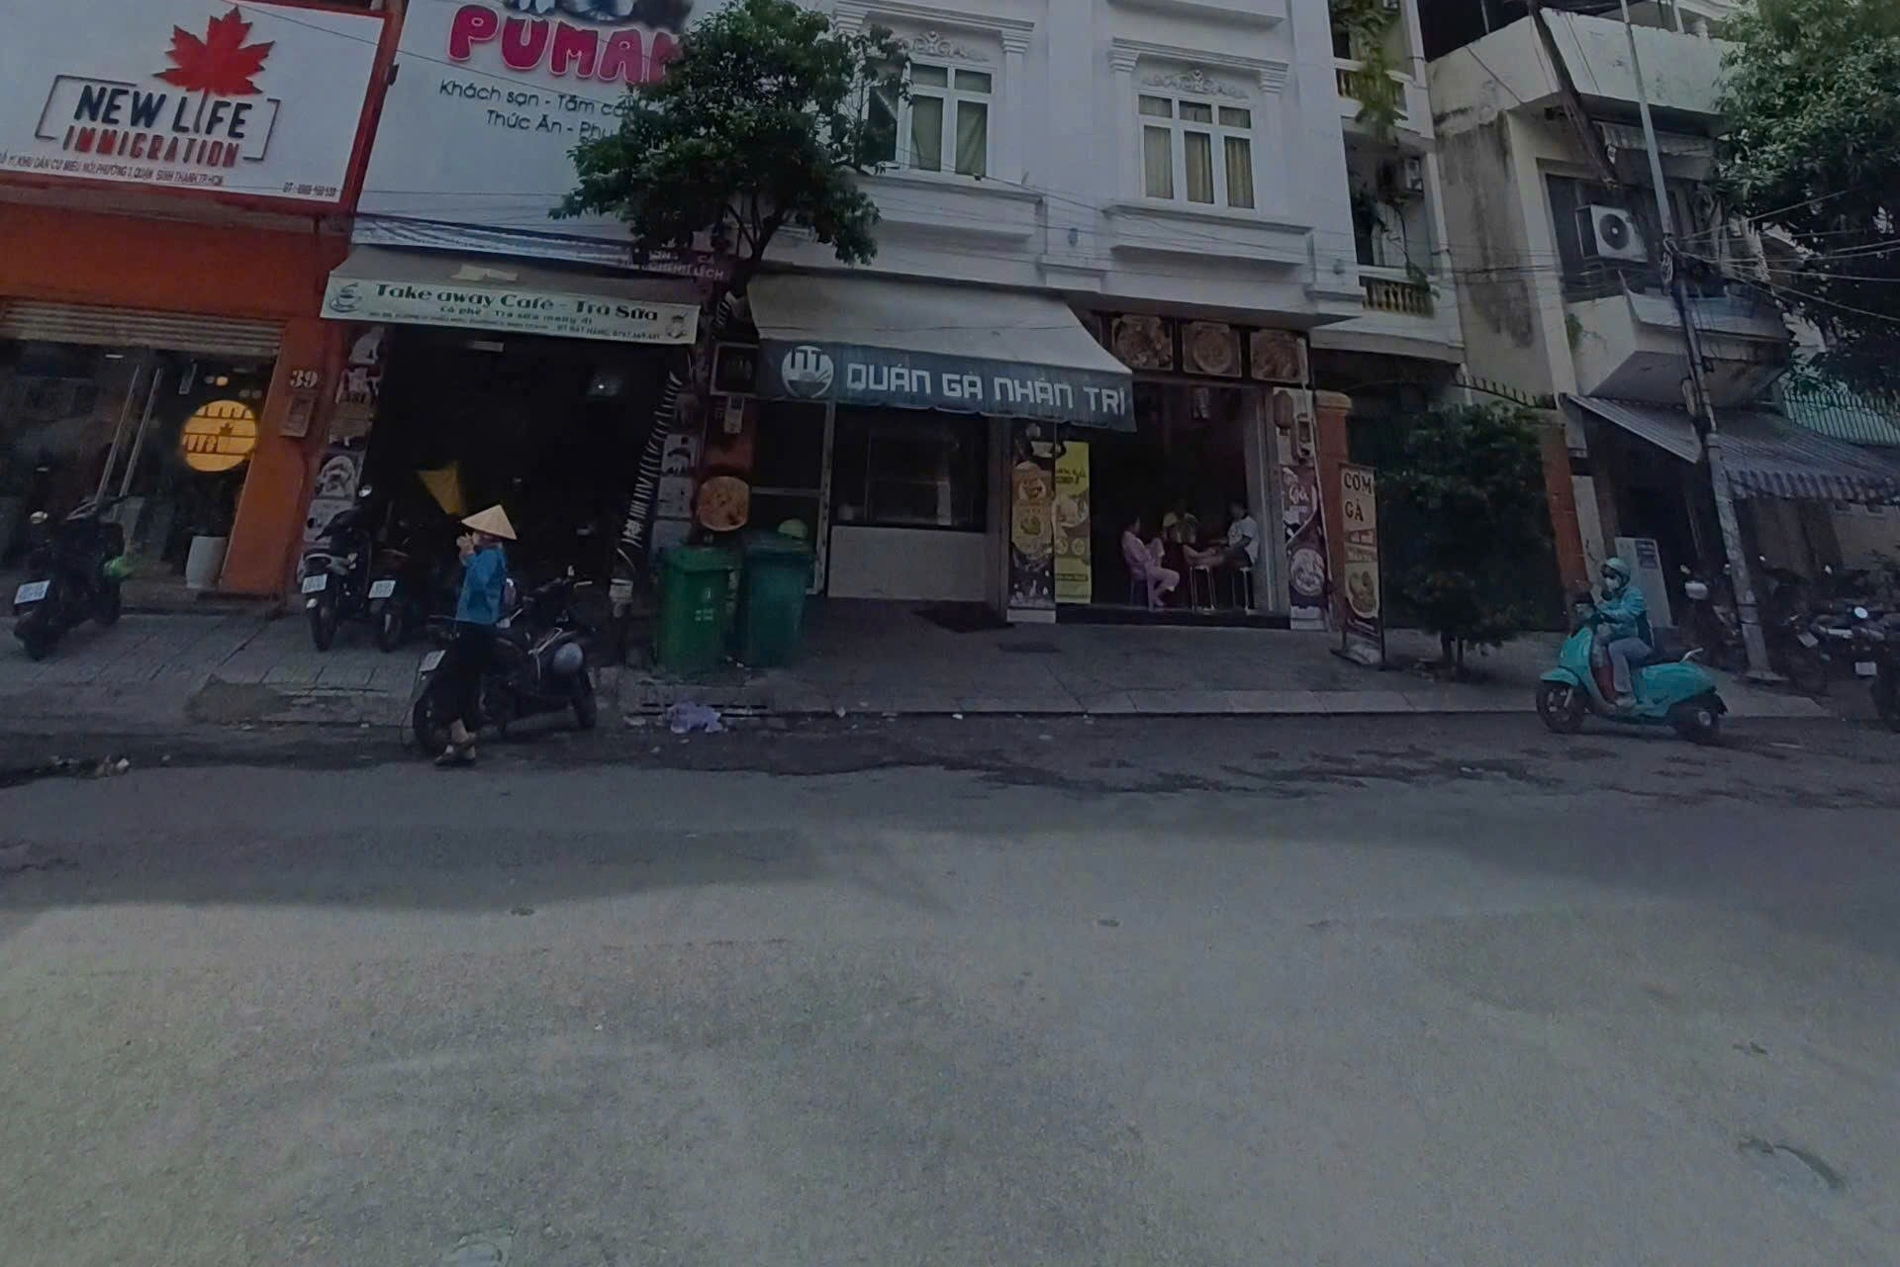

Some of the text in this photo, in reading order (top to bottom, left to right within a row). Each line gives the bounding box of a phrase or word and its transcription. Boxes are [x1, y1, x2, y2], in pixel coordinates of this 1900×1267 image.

[73, 84, 253, 139] NEW LIFE
[439, 79, 501, 100] Khách
[506, 91, 539, 108] sạn
[486, 109, 531, 131] Thức
[535, 113, 563, 135] Ăn
[62, 124, 241, 169] IMMIGRATION
[375, 283, 433, 301] Take
[436, 290, 496, 309] away
[615, 304, 659, 322] Sữa
[847, 362, 932, 395] QUÁN
[941, 370, 984, 401] GÀ
[1344, 498, 1365, 522] GÀ
